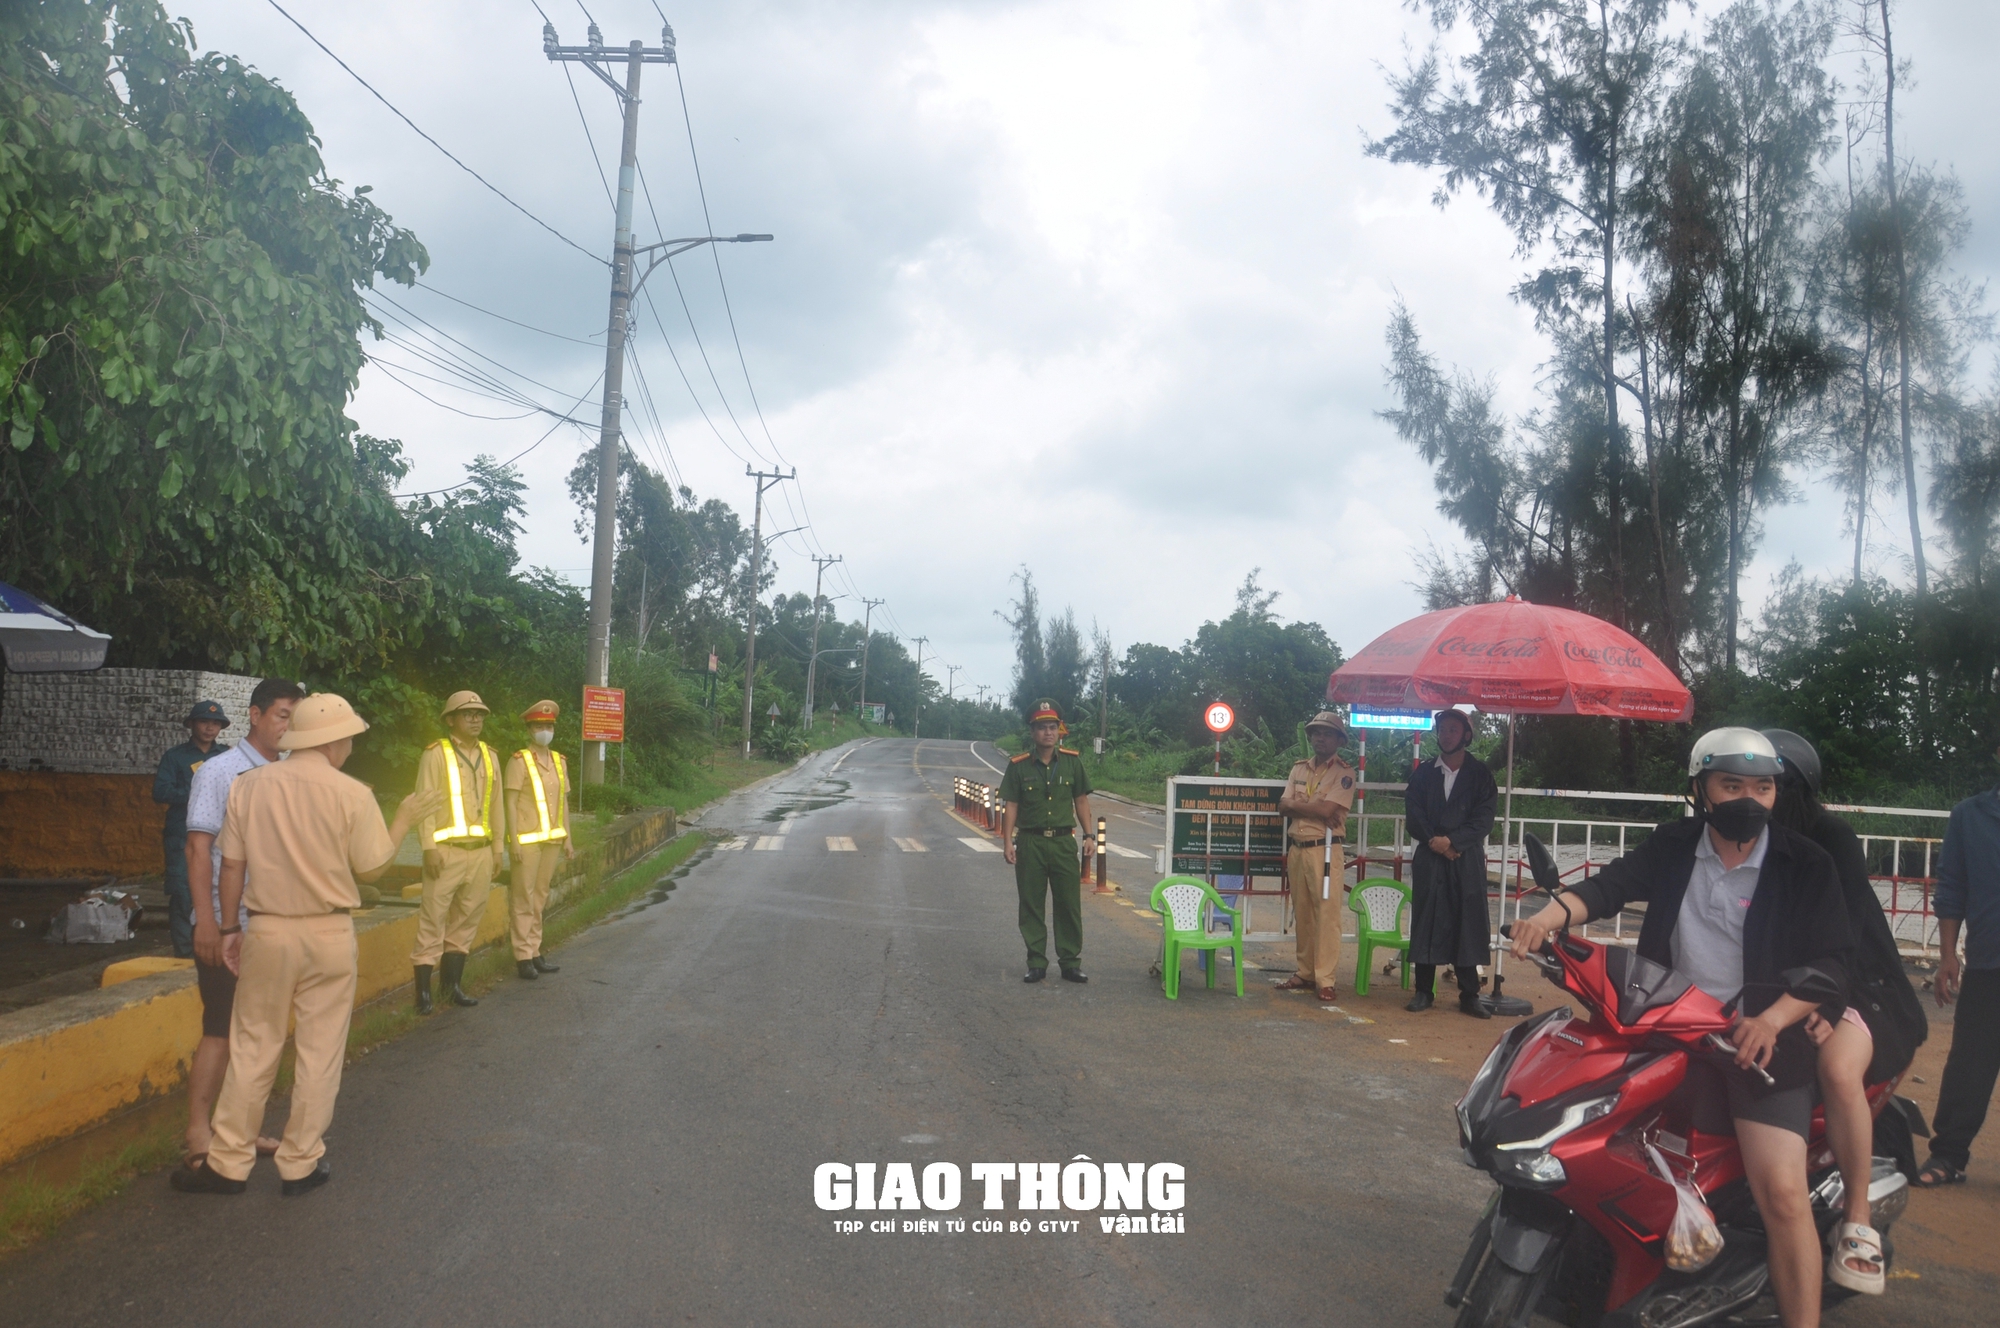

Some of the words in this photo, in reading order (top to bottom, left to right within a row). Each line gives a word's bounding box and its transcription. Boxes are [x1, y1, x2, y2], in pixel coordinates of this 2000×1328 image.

[1233, 800, 1256, 811] KHÁCH
[1231, 815, 1254, 826] THÔG
[1557, 1031, 1584, 1047] HONDA
